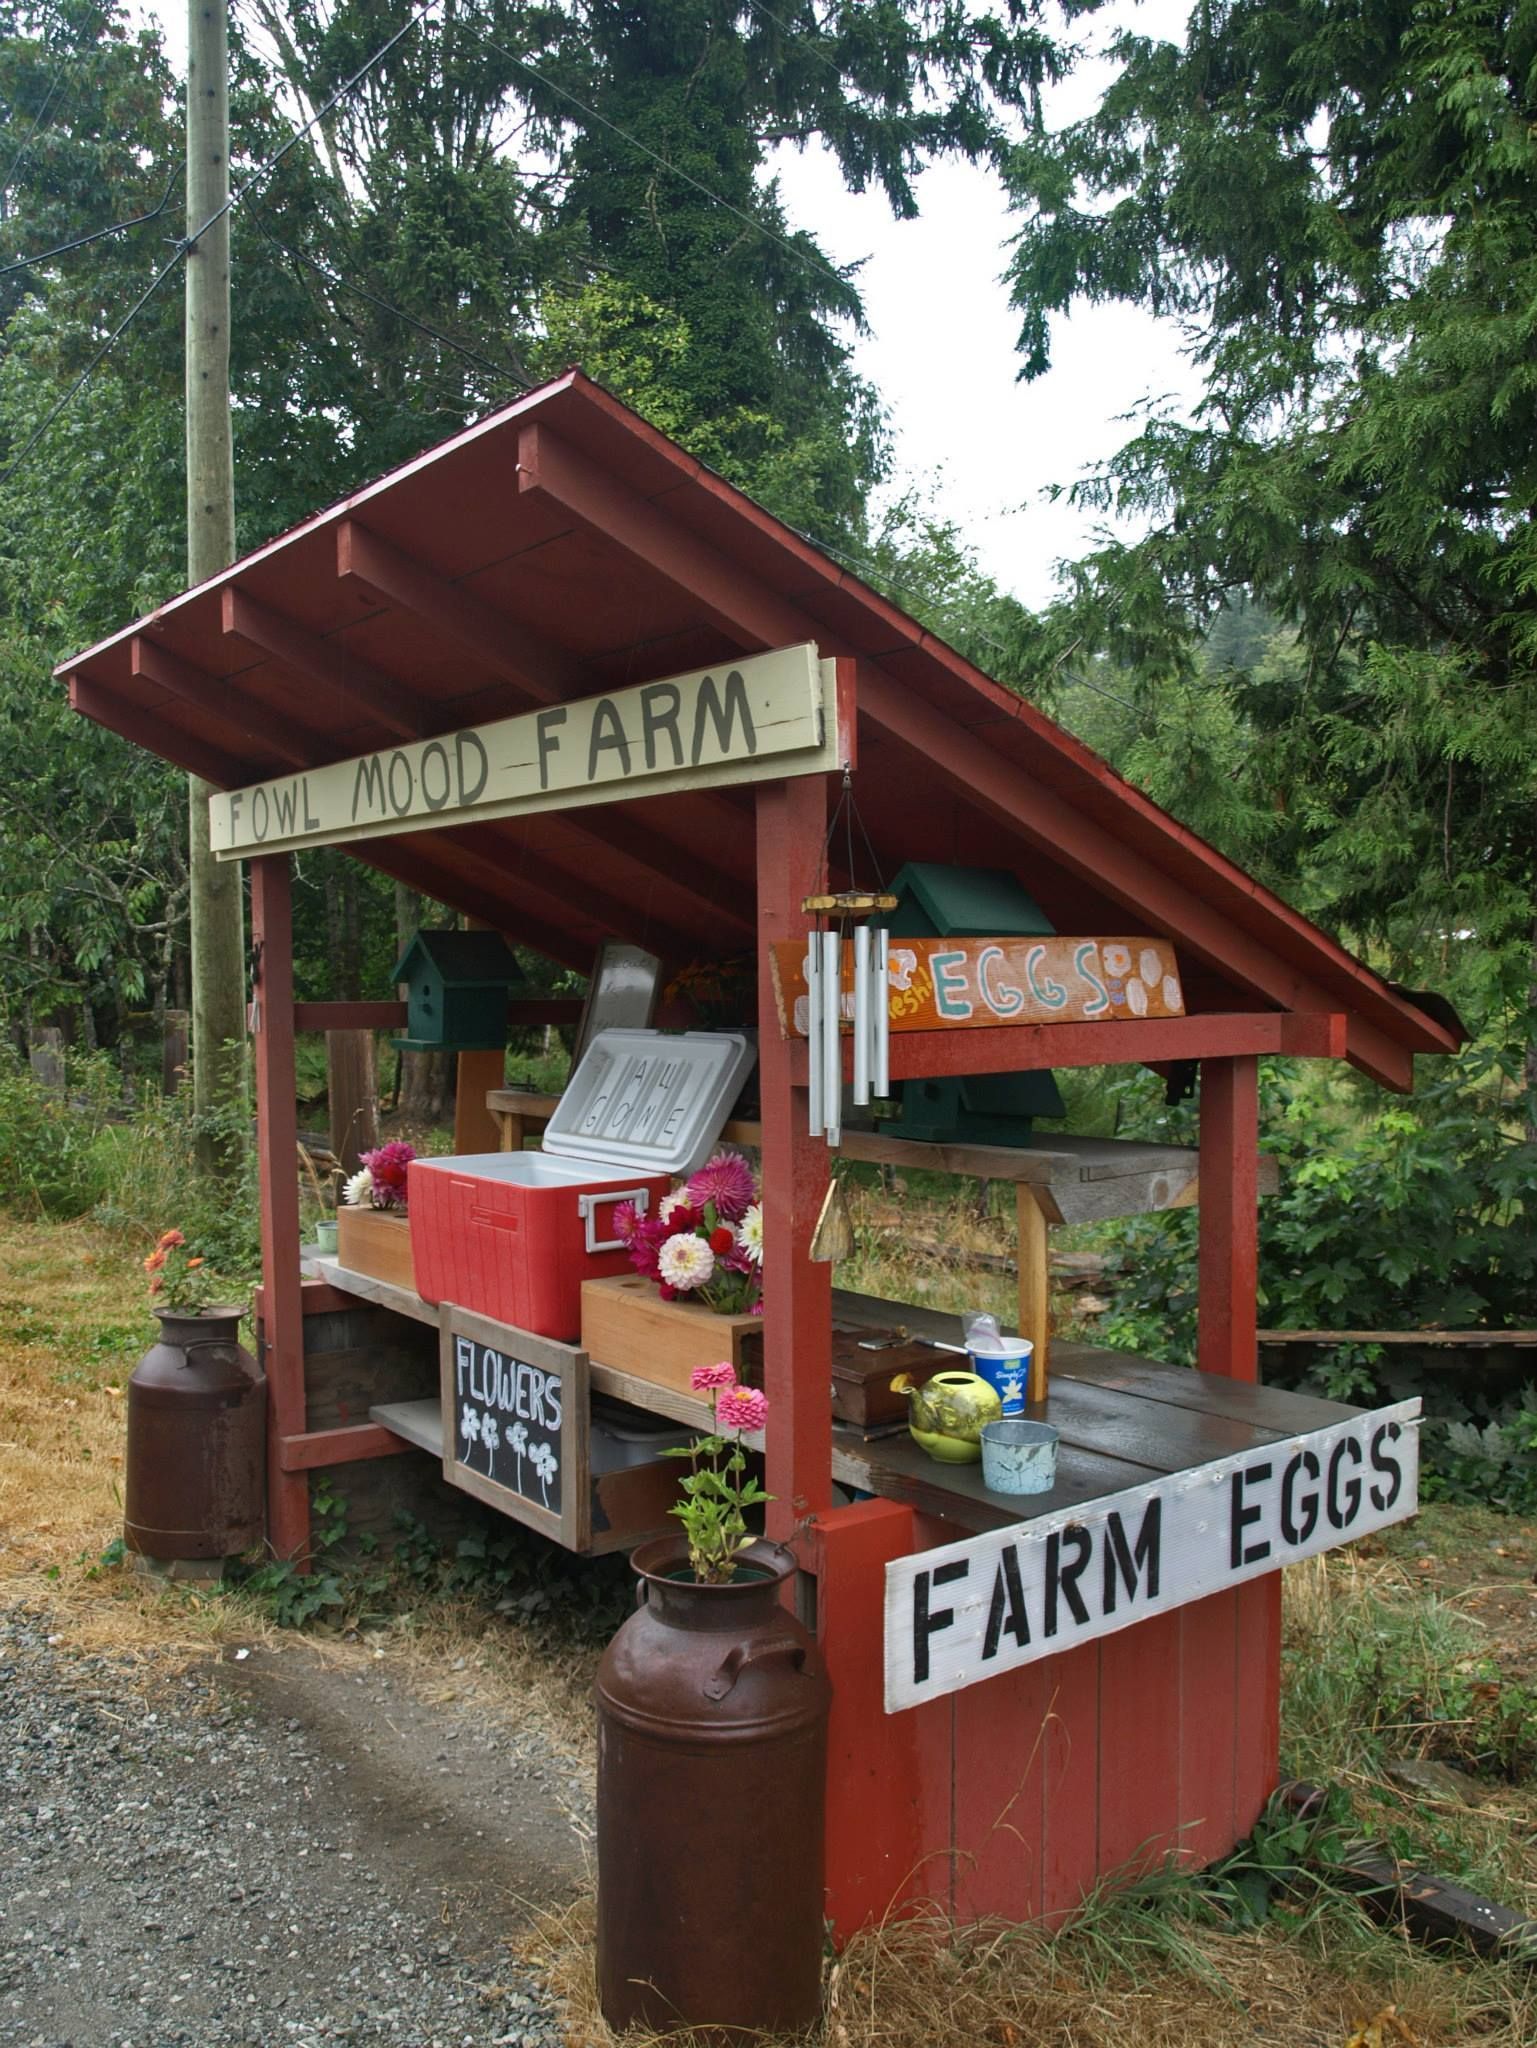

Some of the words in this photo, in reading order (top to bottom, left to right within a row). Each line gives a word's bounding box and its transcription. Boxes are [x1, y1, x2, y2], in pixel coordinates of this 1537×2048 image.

[231, 776, 320, 846] FOWL
[352, 730, 489, 823] MOOD
[536, 670, 757, 790] FARM
[888, 965, 933, 1020] esh!
[929, 942, 1110, 1020] EGGS
[586, 1095, 685, 1135] GONE
[456, 1335, 562, 1432] FLOWERS
[913, 1497, 1162, 1685] FARM
[1231, 1421, 1402, 1570] EGGS
